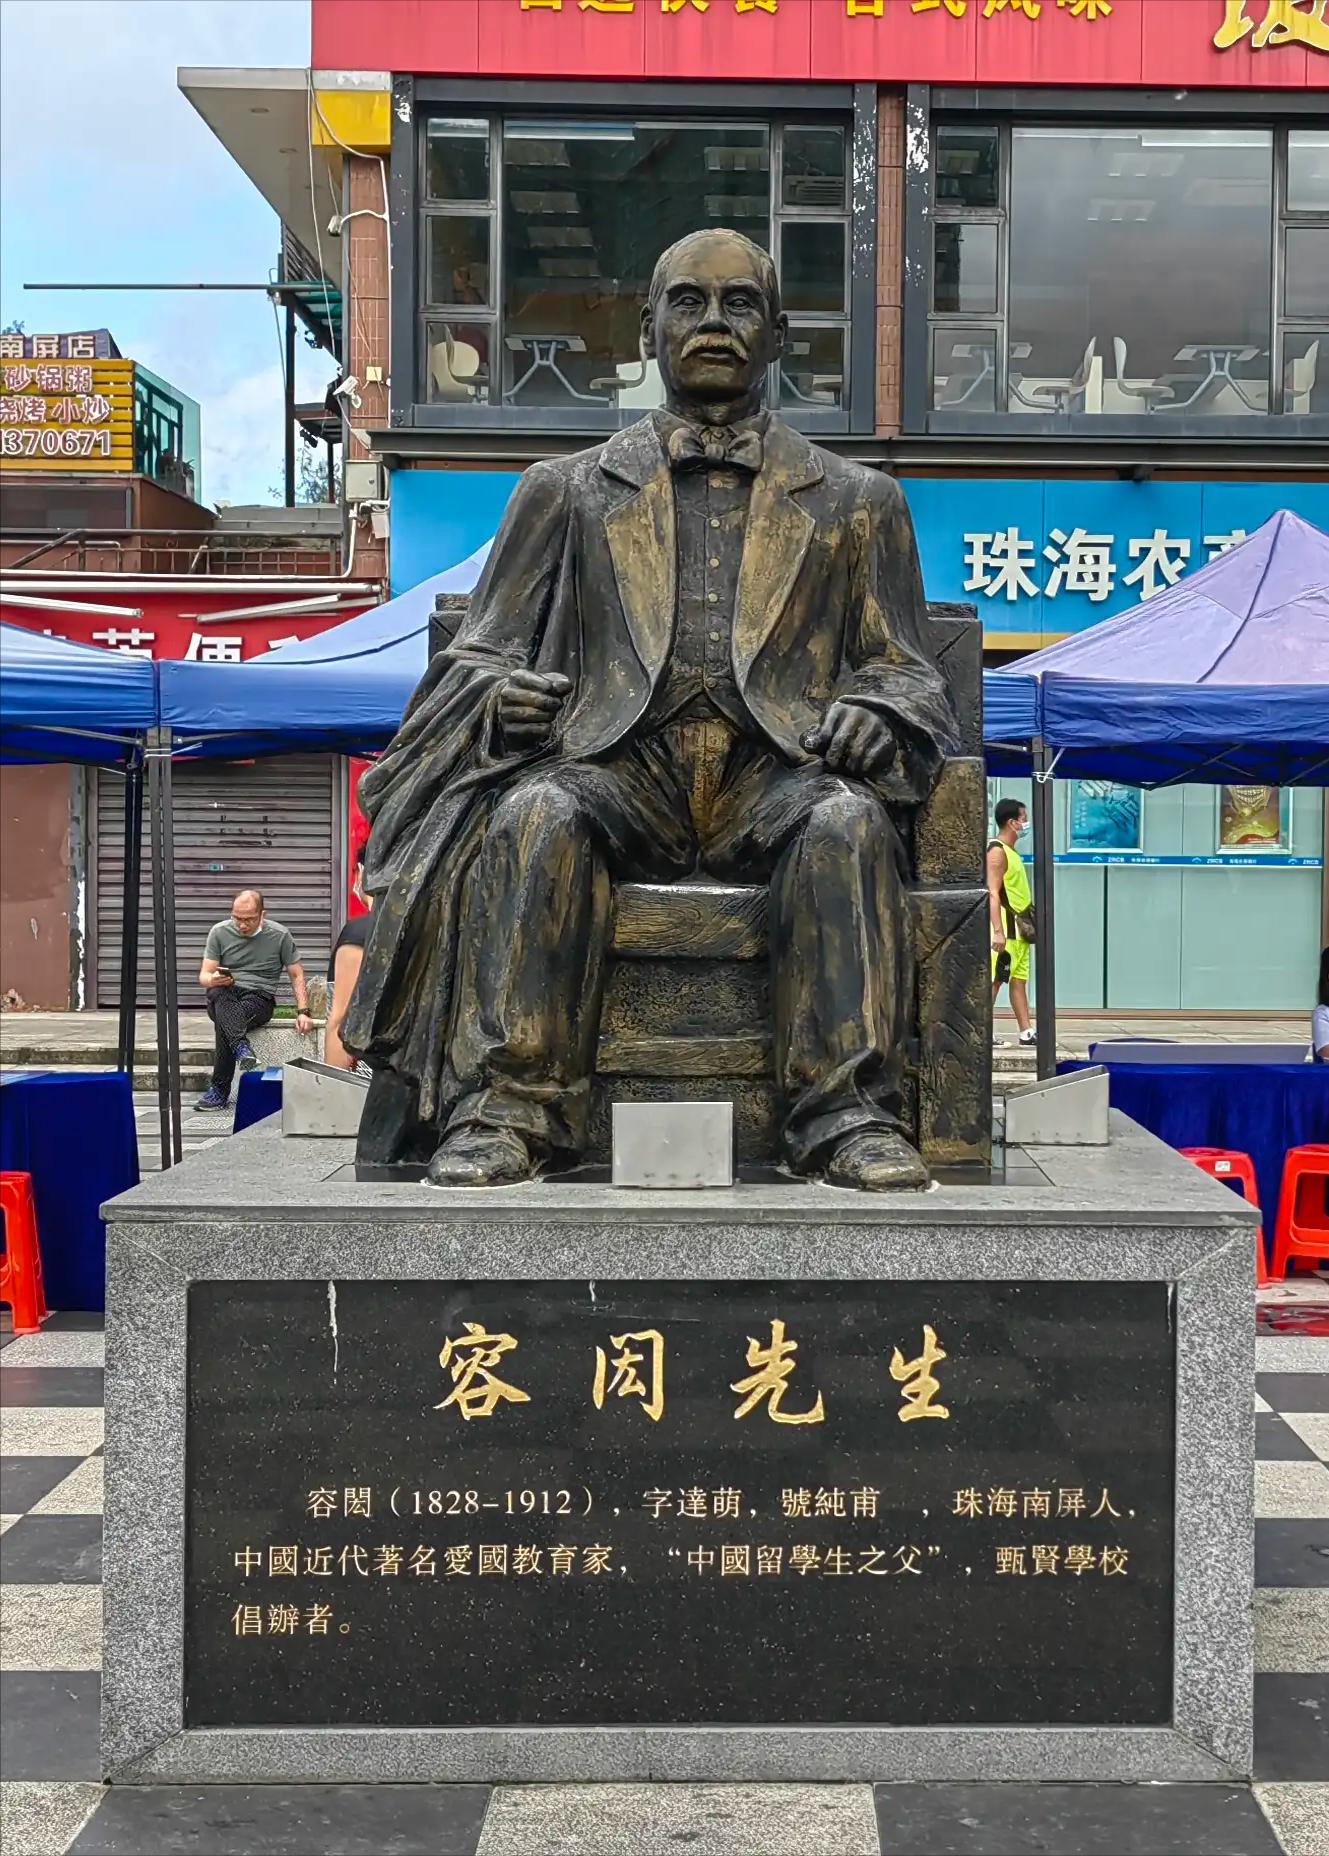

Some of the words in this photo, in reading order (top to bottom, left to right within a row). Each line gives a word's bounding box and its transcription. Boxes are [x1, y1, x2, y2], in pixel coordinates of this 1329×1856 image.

[0, 334, 96, 359] 南屏店
[5, 363, 93, 392] 砂锅粥
[51, 396, 110, 424] 小炒
